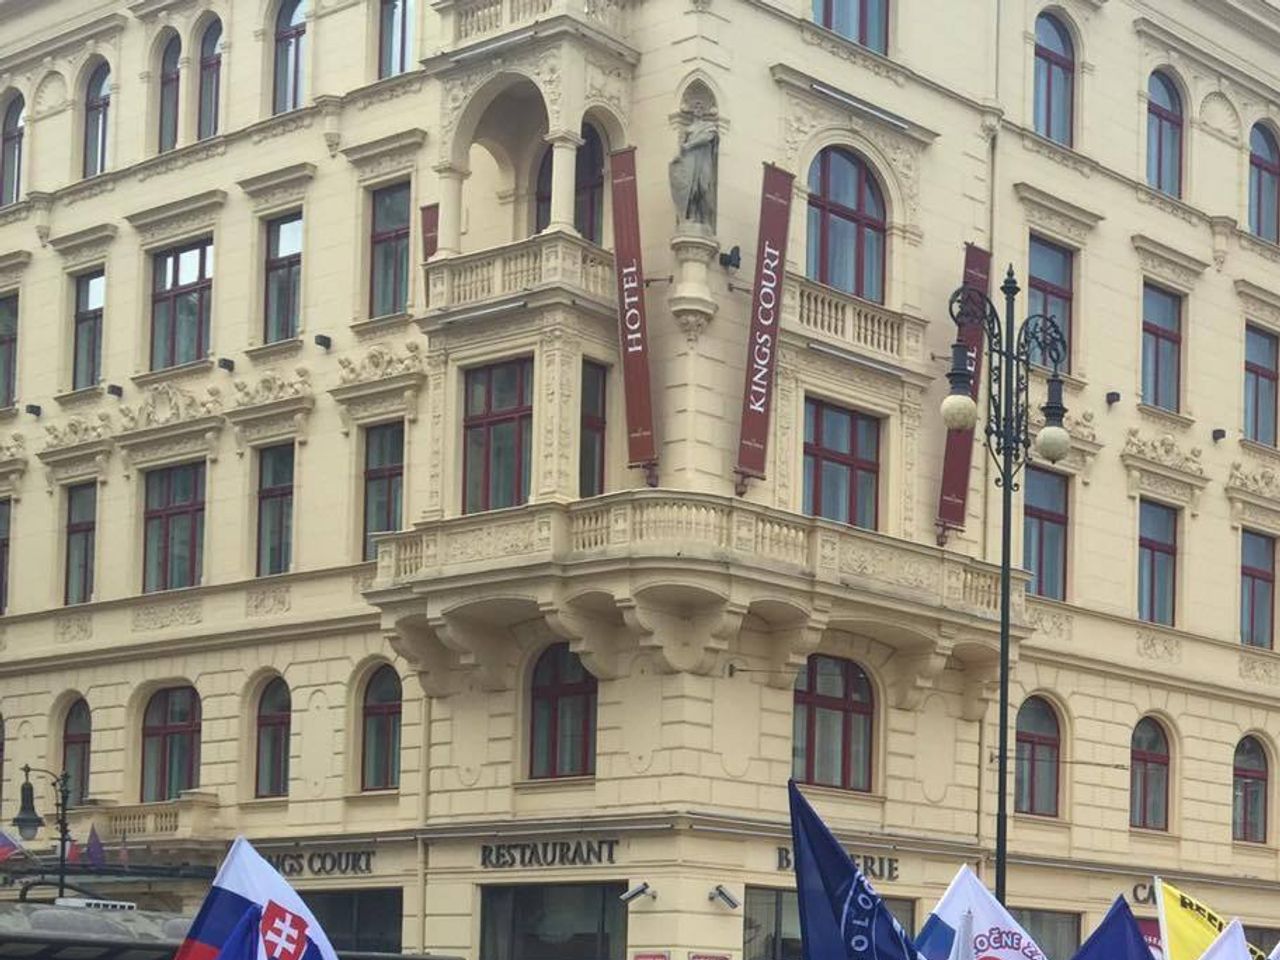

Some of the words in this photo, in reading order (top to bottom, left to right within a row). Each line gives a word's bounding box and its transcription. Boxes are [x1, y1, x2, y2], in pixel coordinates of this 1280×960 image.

[622, 258, 643, 353] HOTEL
[757, 241, 780, 326] COURT
[749, 331, 772, 413] KINGS
[308, 850, 377, 874] COURT
[480, 839, 620, 869] RESTAURANT
[974, 927, 1023, 954] OČNE
